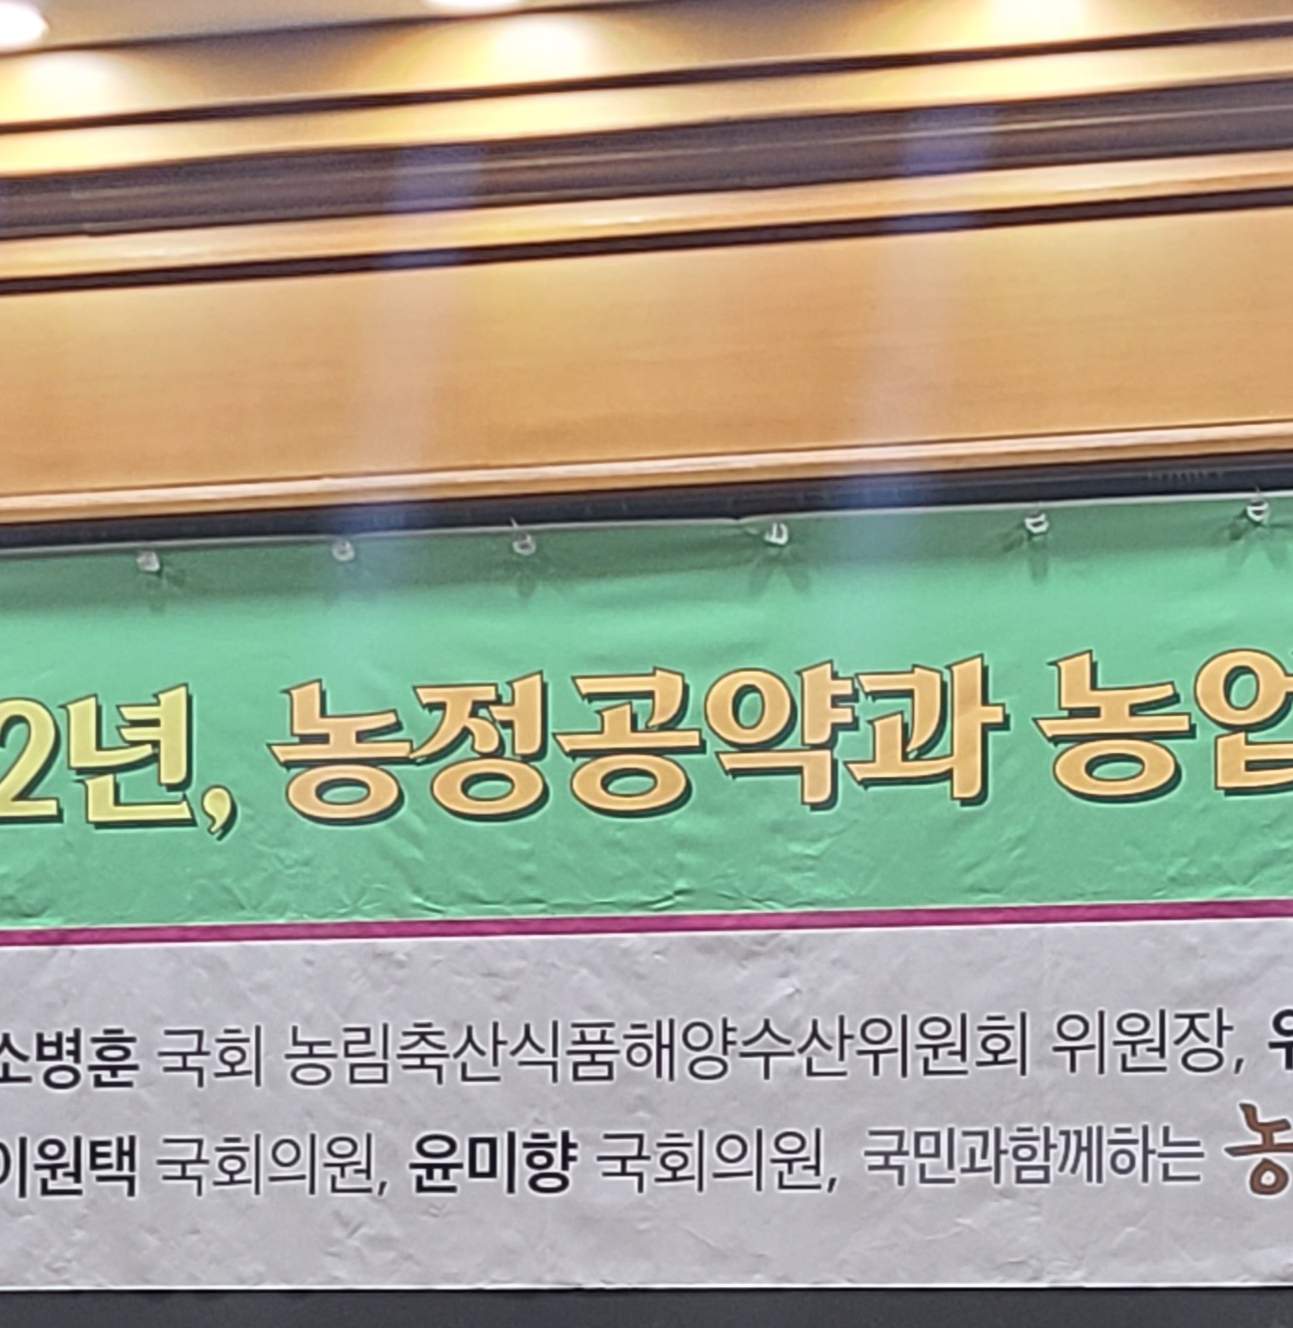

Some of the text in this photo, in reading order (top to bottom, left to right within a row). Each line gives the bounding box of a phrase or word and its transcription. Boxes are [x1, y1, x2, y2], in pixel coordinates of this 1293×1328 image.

[266, 653, 1010, 824] 농정공약과
[158, 1025, 261, 1087] 국회
[285, 1012, 1026, 1085] 농림축산식품해양수산위원회
[1052, 1008, 1243, 1074] 위원장,
[157, 1133, 386, 1196] 국회의원,
[409, 1131, 577, 1193] 윤미향
[597, 1128, 836, 1193] 국회의원,
